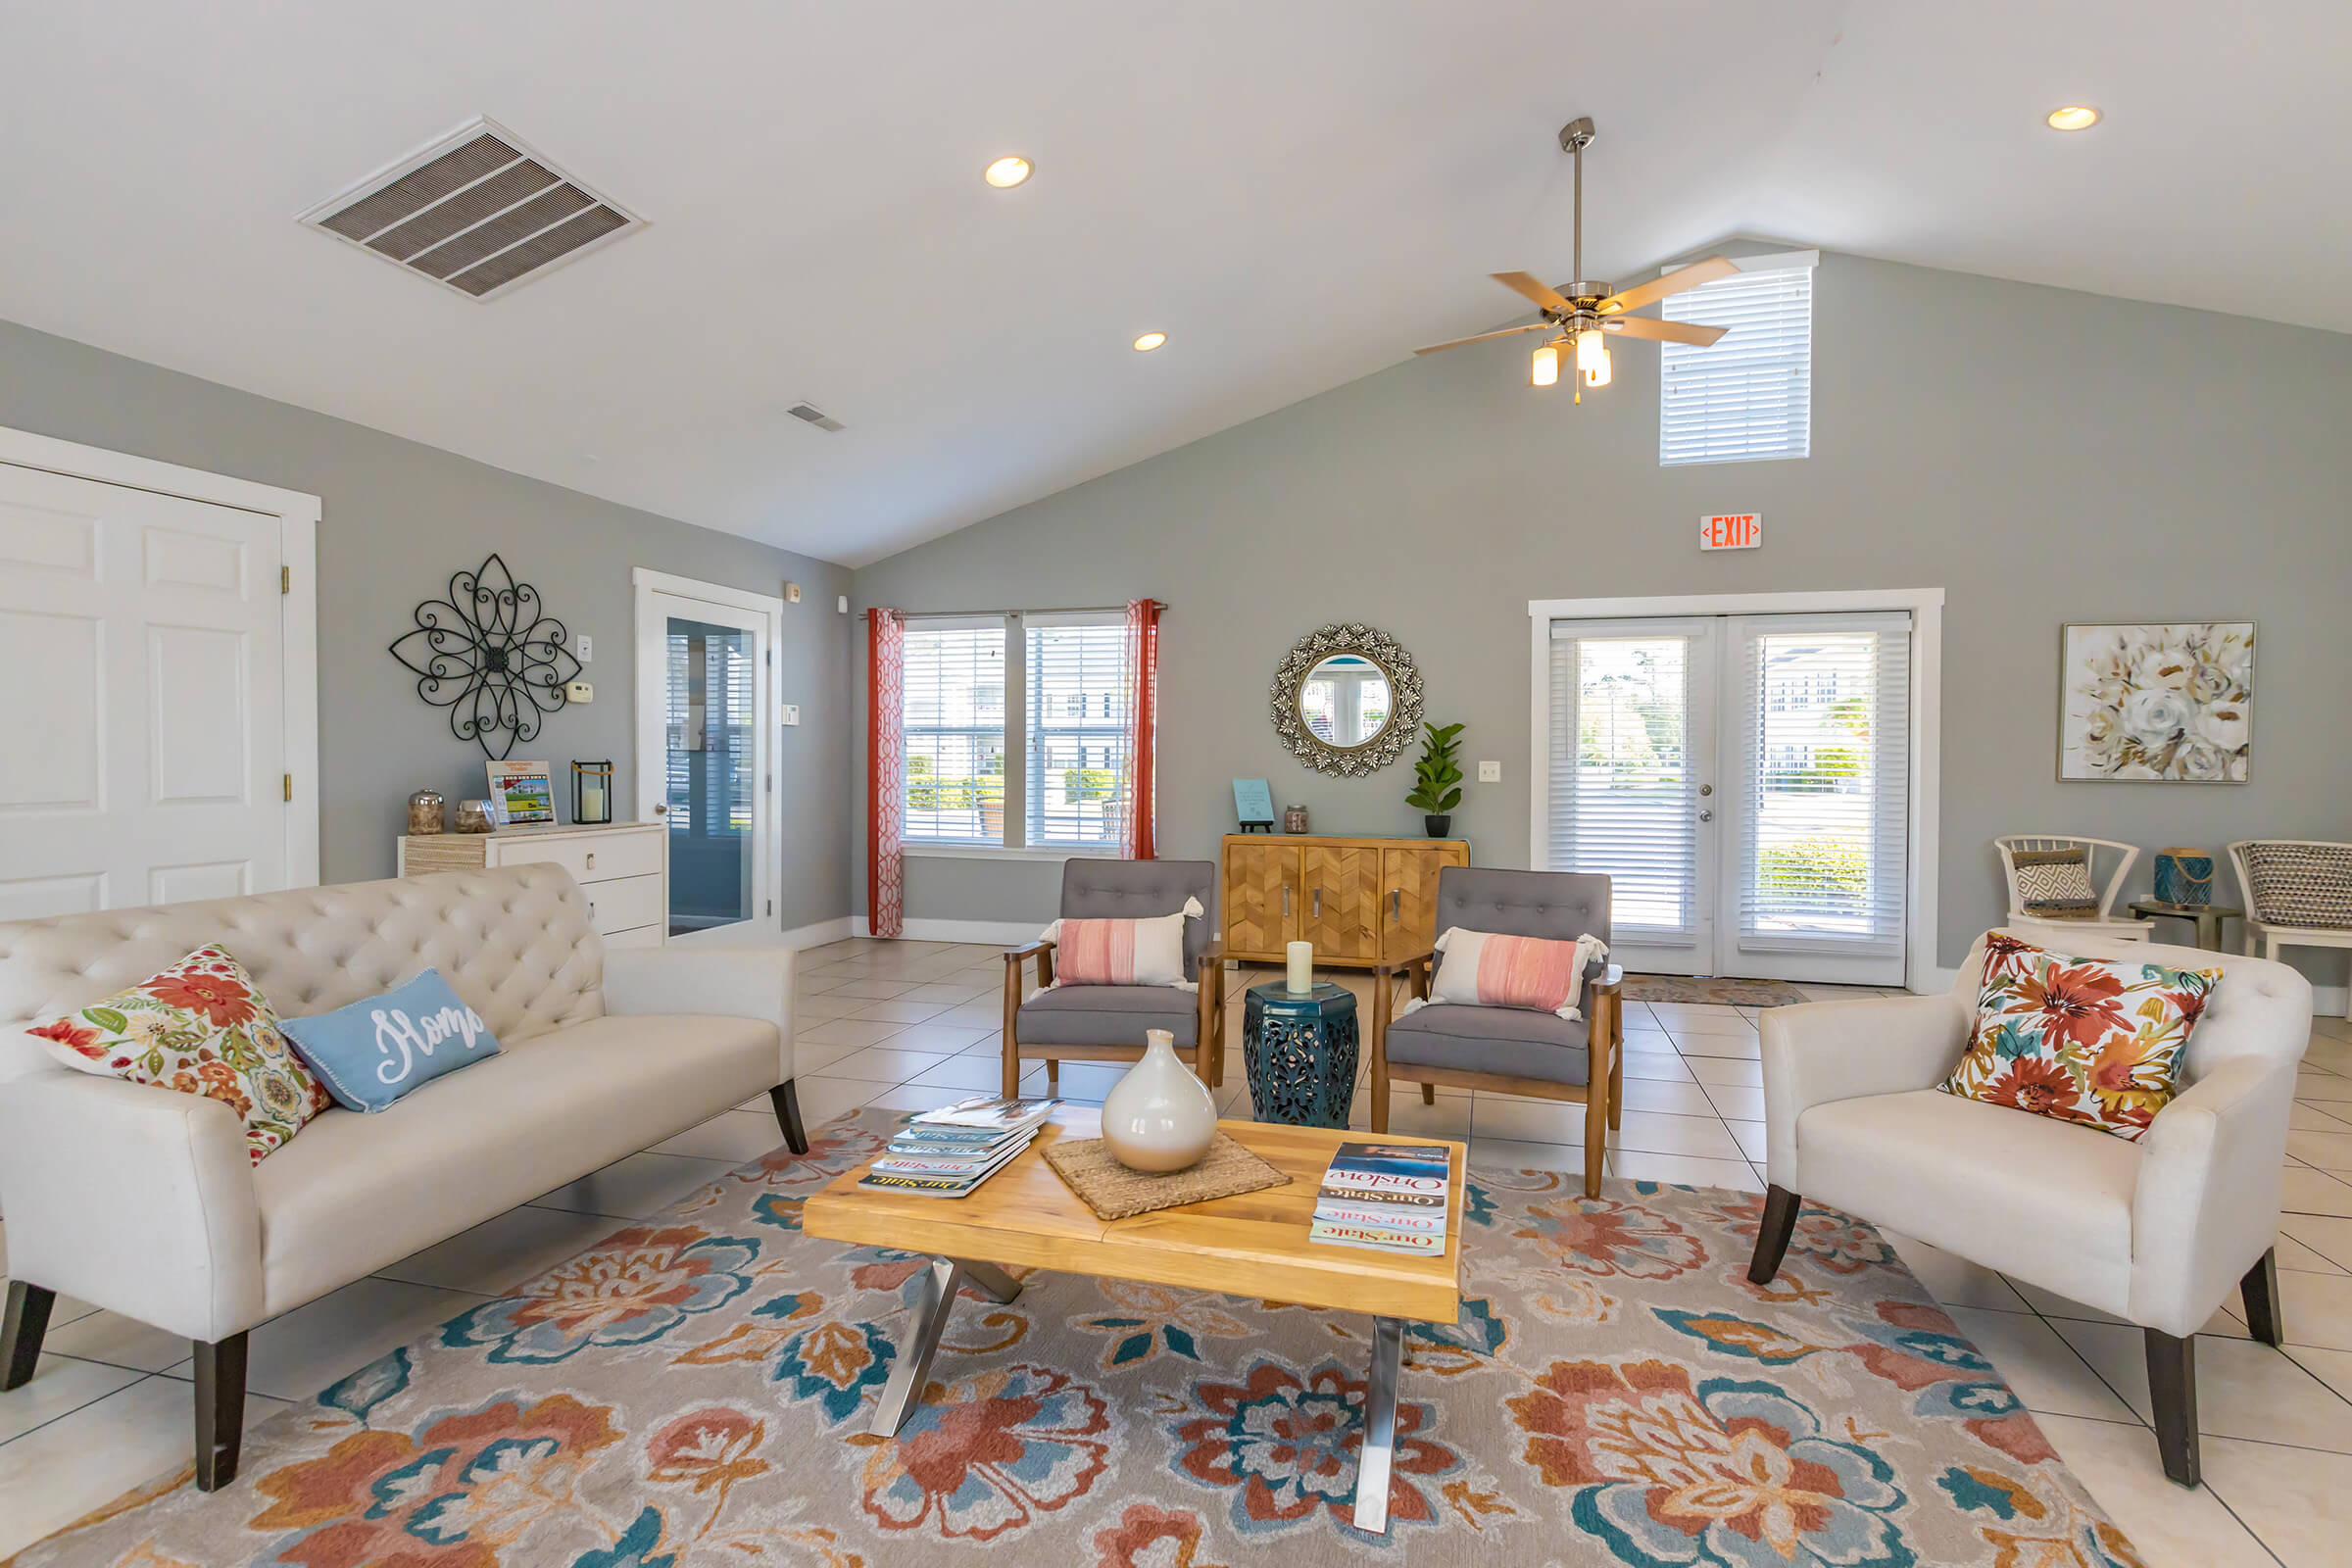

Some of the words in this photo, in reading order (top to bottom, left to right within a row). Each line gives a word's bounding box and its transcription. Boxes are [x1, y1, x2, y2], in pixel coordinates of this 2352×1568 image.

[1711, 515, 1754, 547] EXIT
[872, 1177, 917, 1189] State
[922, 1180, 963, 1190] Our
[1330, 1171, 1443, 1190] Onslow
[1330, 1189, 1384, 1201] State
[1387, 1195, 1435, 1205] Our
[1327, 1210, 1383, 1224] State
[1385, 1217, 1433, 1229] Our
[1323, 1227, 1379, 1242] State
[1383, 1235, 1433, 1247] Our
